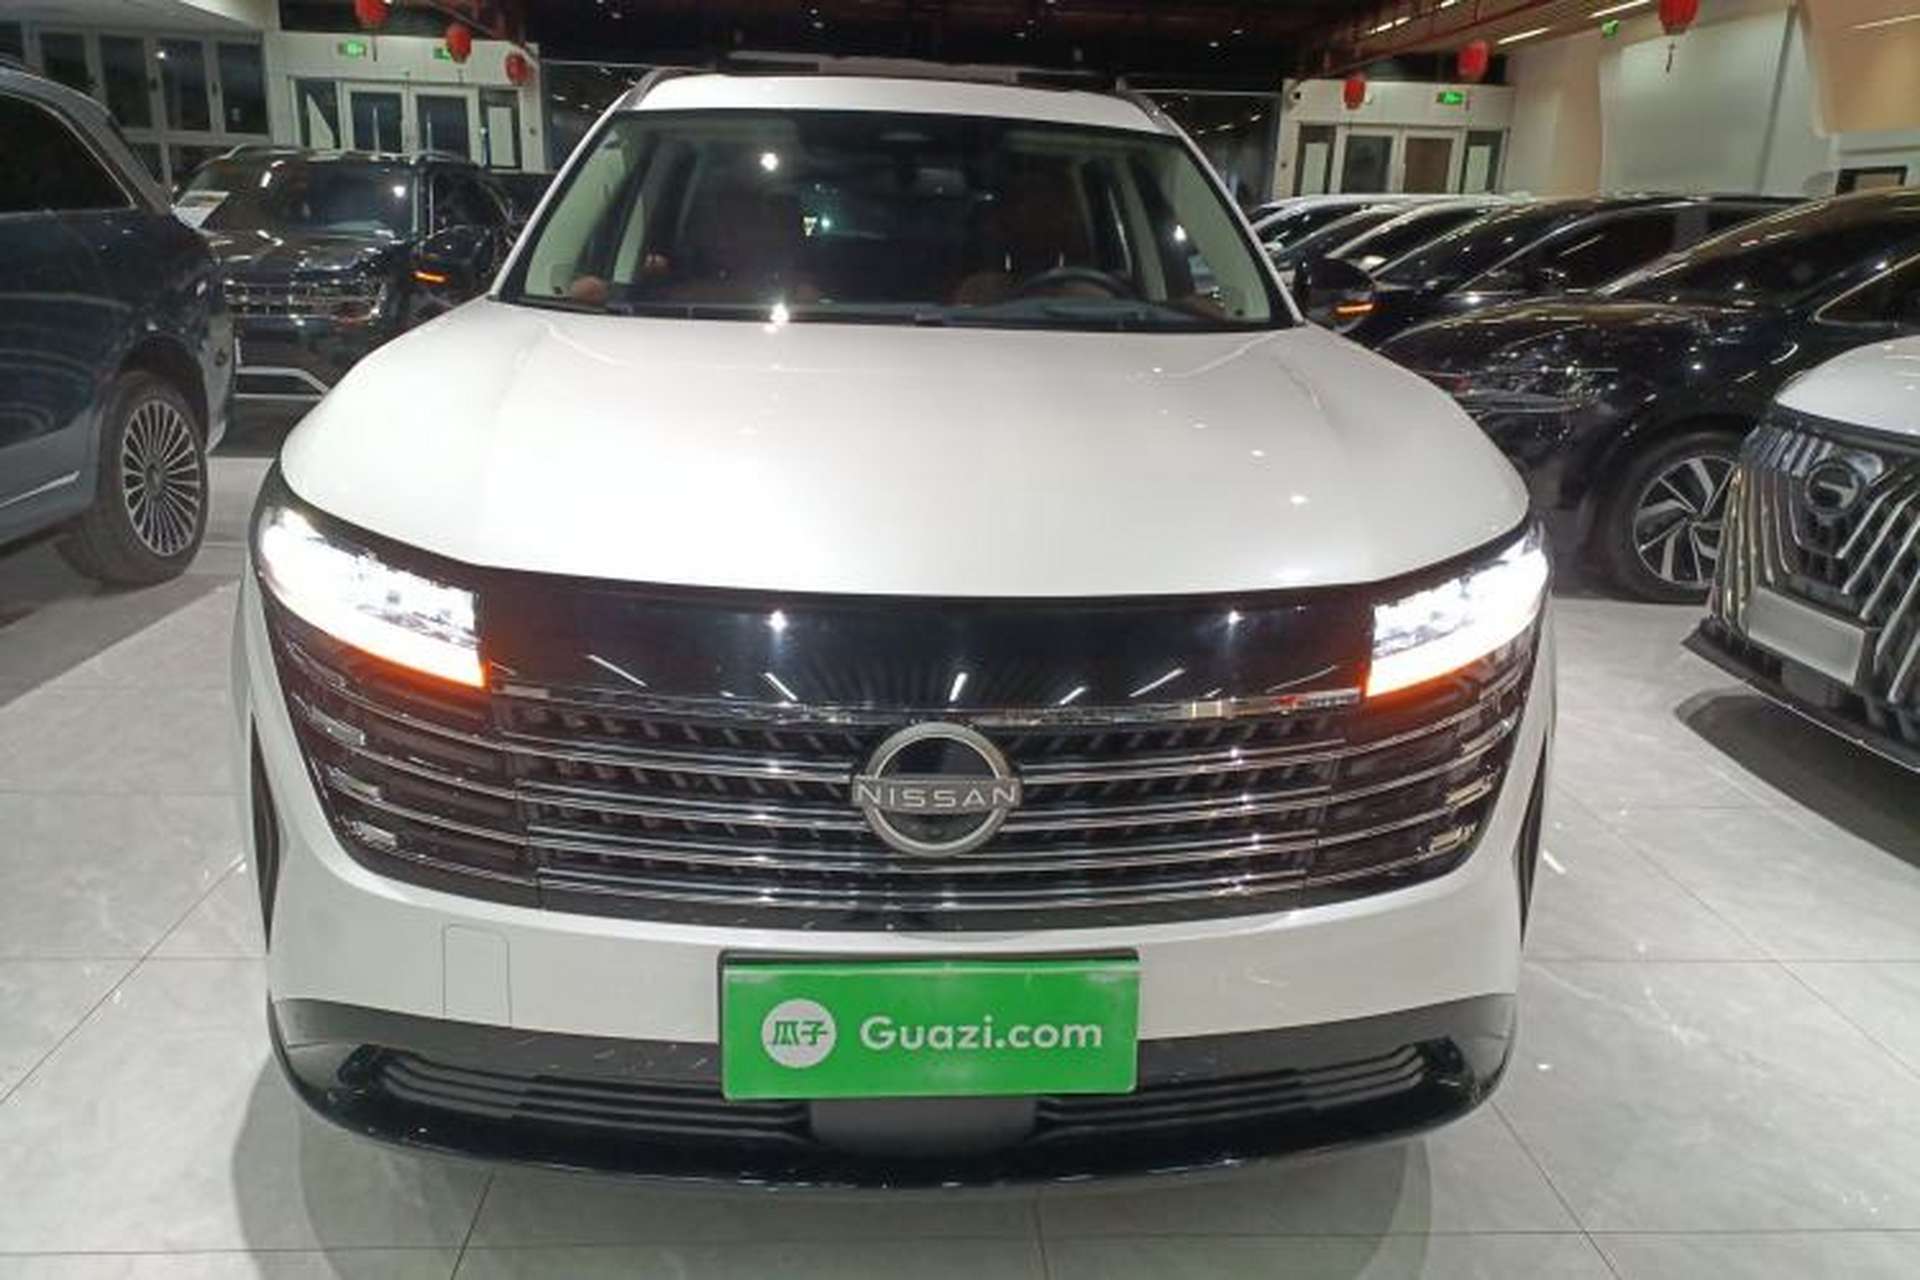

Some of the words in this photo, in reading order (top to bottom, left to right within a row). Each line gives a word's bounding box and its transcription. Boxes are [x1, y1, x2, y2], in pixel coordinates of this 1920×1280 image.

[857, 783, 1016, 808] NISSAN
[772, 1020, 828, 1046] 瓜子
[859, 1014, 1103, 1051] Guazi.com
